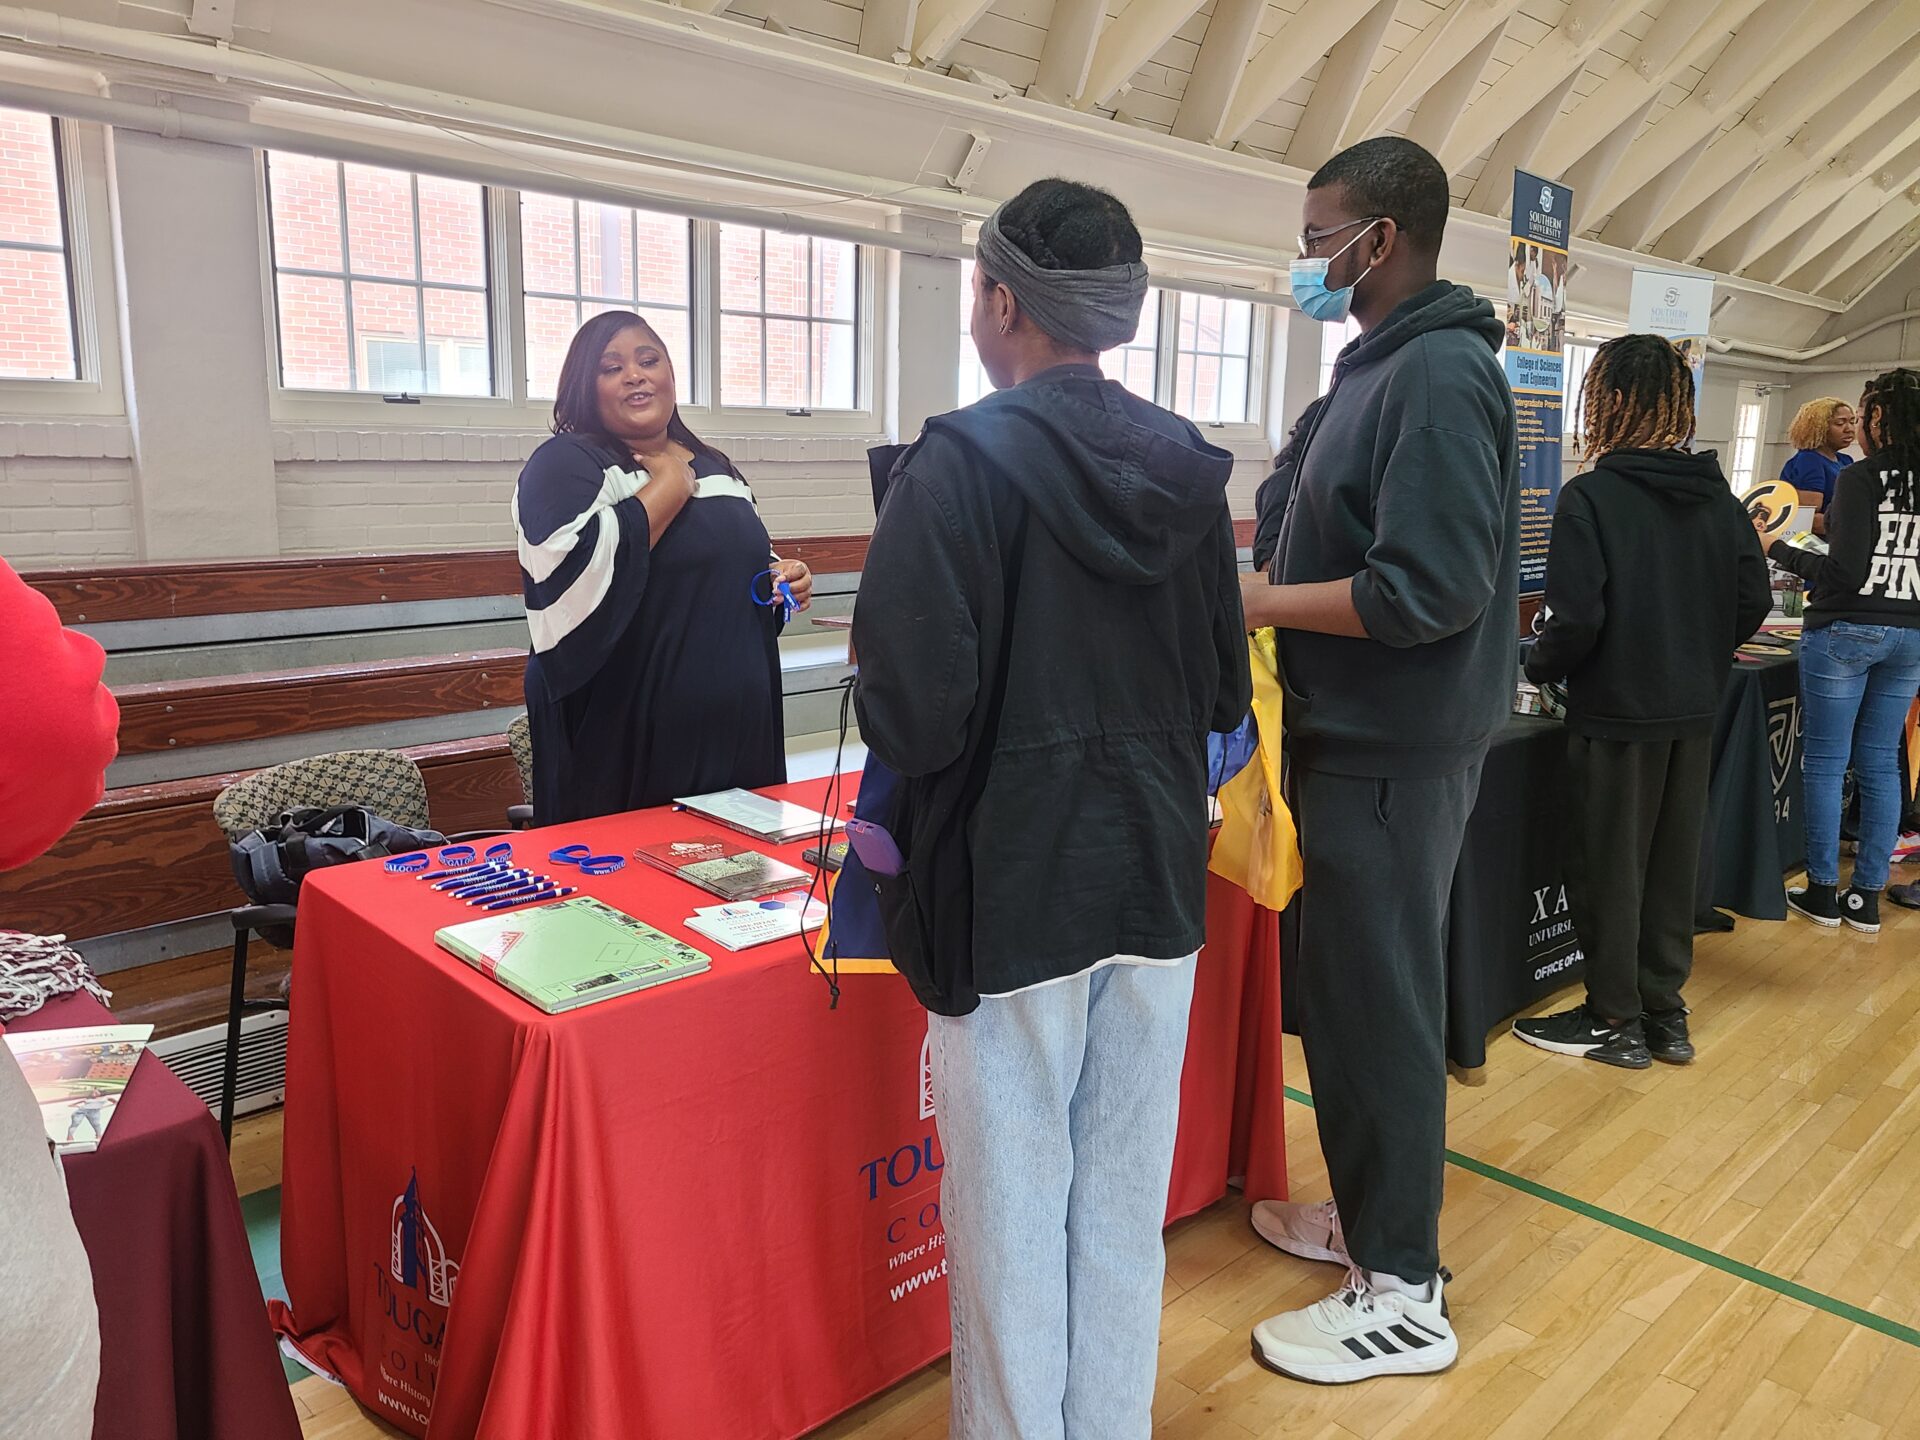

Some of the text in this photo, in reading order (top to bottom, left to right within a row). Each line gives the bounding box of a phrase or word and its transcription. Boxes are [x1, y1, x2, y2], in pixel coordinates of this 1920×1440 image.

[1529, 210, 1562, 230] SOUTHERN
[1529, 222, 1562, 238] UNIVERSITY
[1650, 306, 1688, 318] SOUTHERN
[1516, 355, 1534, 371] College
[1540, 358, 1562, 373] Sciences
[1519, 373, 1557, 388] and Engineering
[1528, 919, 1575, 947] UNIVERSI
[1534, 959, 1564, 981] OFFICE
[1564, 954, 1575, 968] OF
[888, 1243, 926, 1271] Where
[400, 1379, 431, 1408] History
[378, 1388, 430, 1425] www.to
